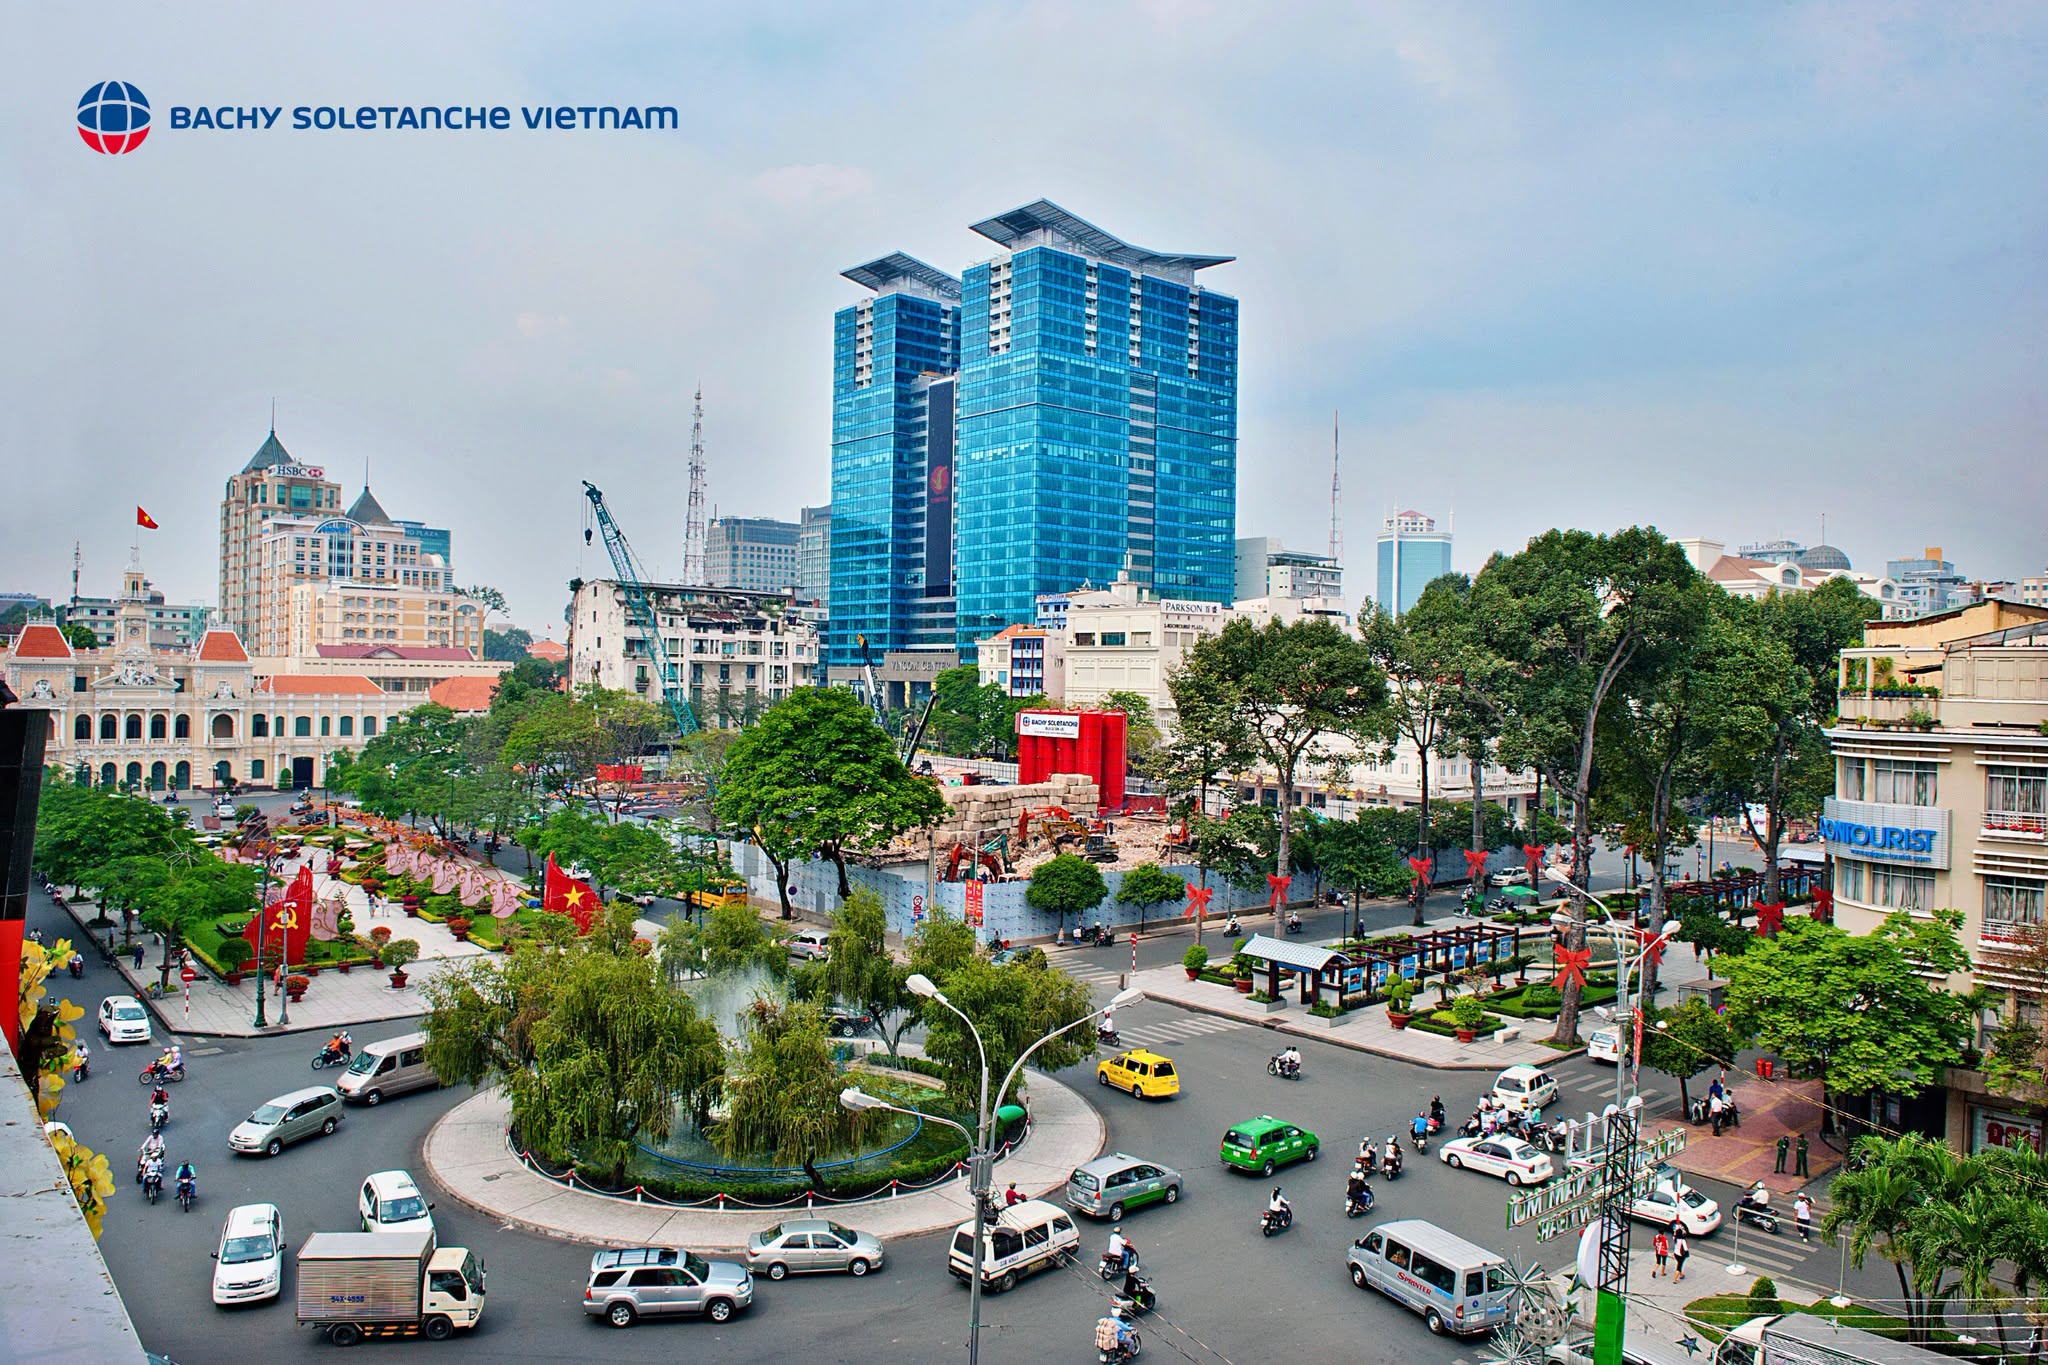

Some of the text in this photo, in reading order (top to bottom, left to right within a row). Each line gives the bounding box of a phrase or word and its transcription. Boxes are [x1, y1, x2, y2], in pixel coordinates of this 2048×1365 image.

[278, 466, 307, 477] HSBC
[1166, 602, 1202, 613] PARKSON
[891, 661, 950, 671] VINCOM CENTER
[1397, 1271, 1432, 1296] SPRINTER
